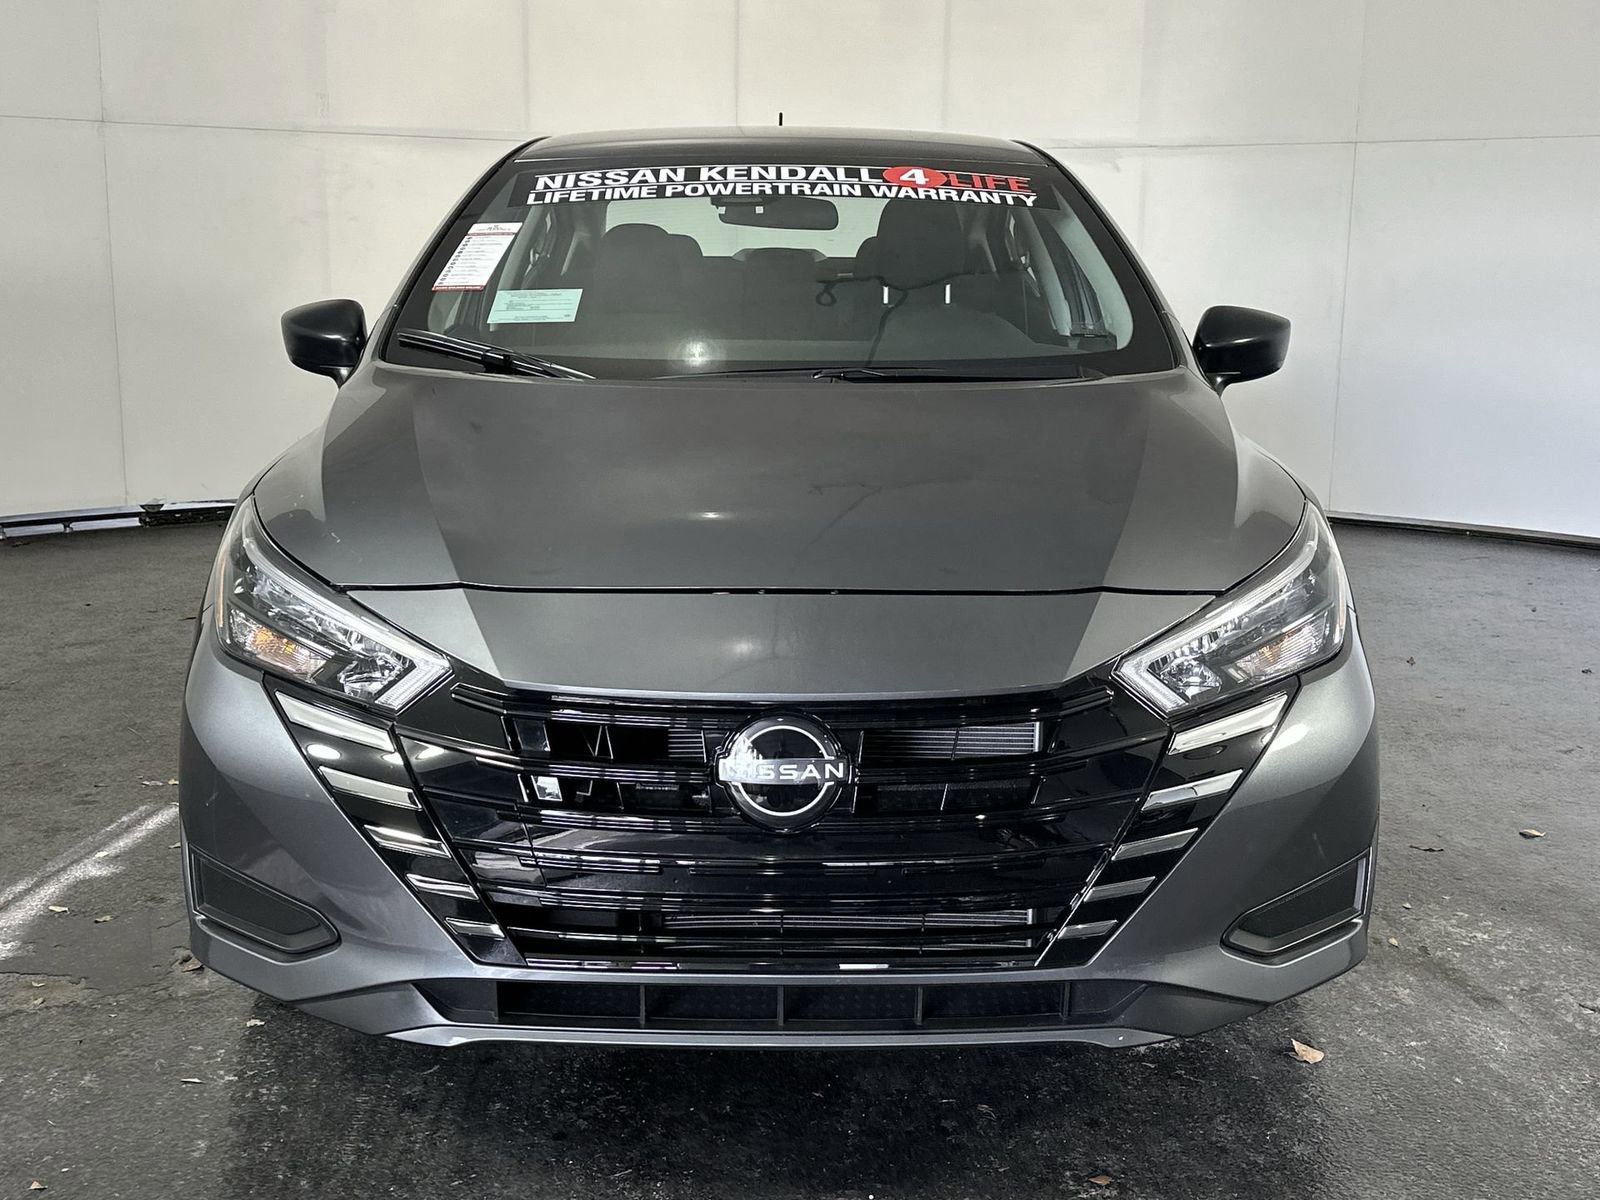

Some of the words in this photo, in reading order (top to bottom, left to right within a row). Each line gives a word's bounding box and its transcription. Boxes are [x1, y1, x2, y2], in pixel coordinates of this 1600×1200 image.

[535, 167, 685, 190] NISSAN
[700, 166, 883, 184] KENDALL
[900, 168, 930, 185] 4
[949, 173, 1031, 192] LIFE
[526, 185, 657, 205] LIFETIME
[664, 183, 861, 198] POWERTRAIN
[868, 185, 1037, 207] WARRANTY
